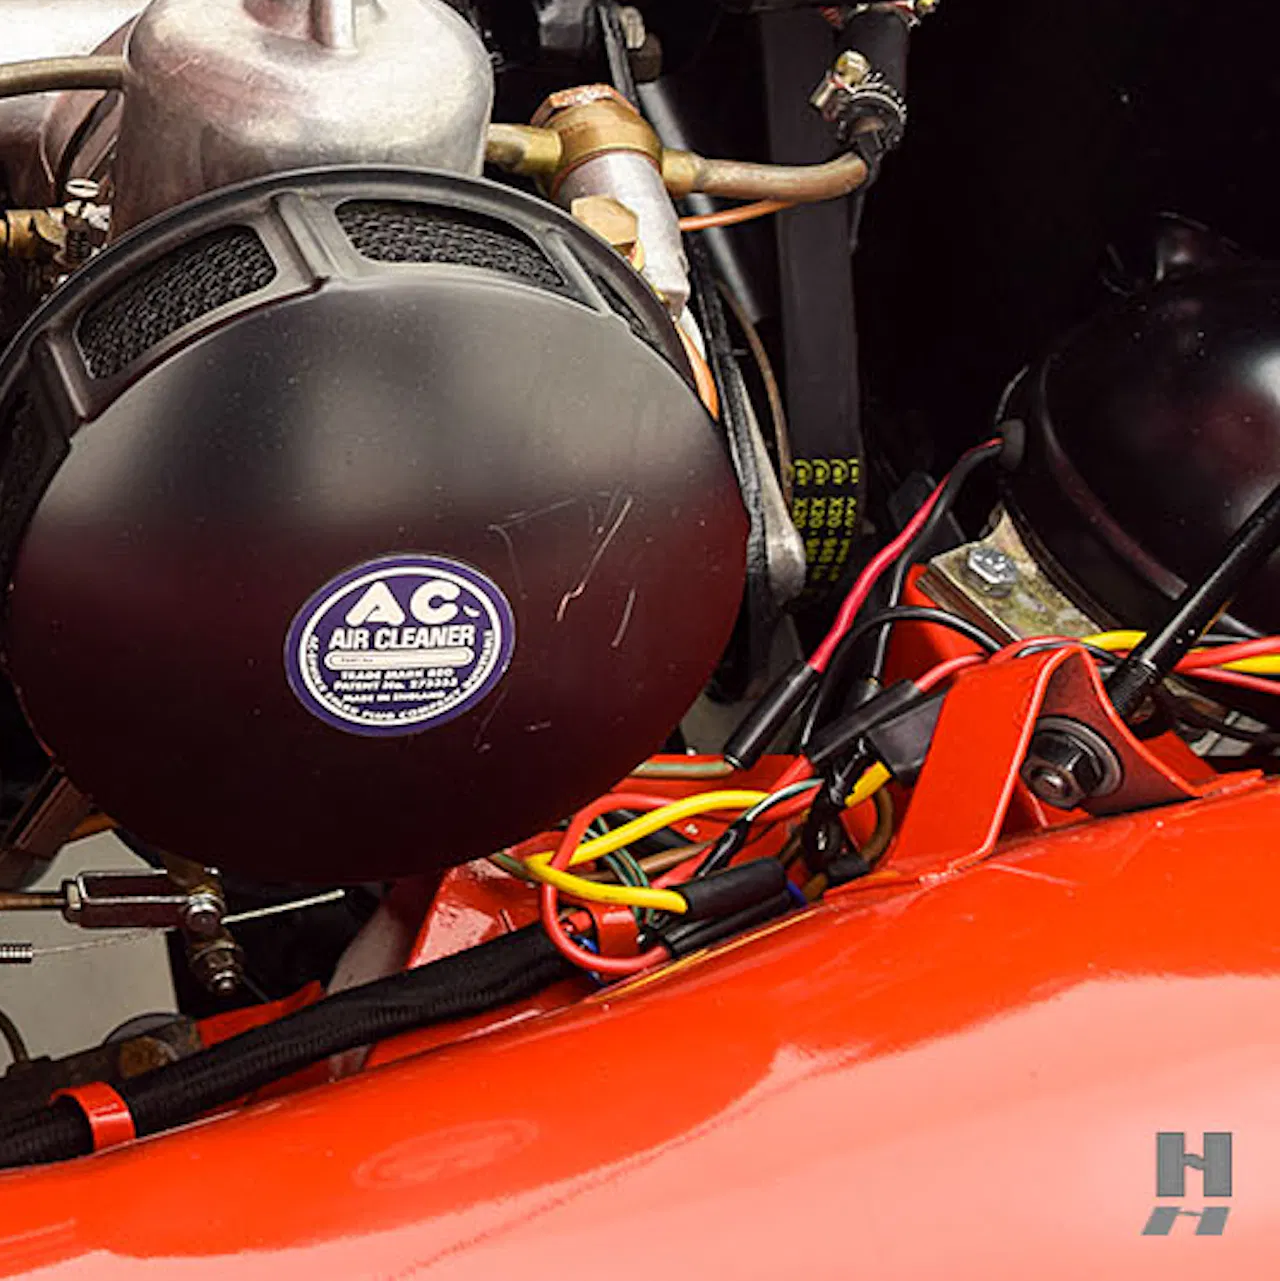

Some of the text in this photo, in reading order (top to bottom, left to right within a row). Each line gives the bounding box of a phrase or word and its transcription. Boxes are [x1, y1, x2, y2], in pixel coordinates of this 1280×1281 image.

[345, 579, 461, 627] AC
[328, 625, 476, 650] AIR CLEANER
[333, 680, 381, 691] PATENT
